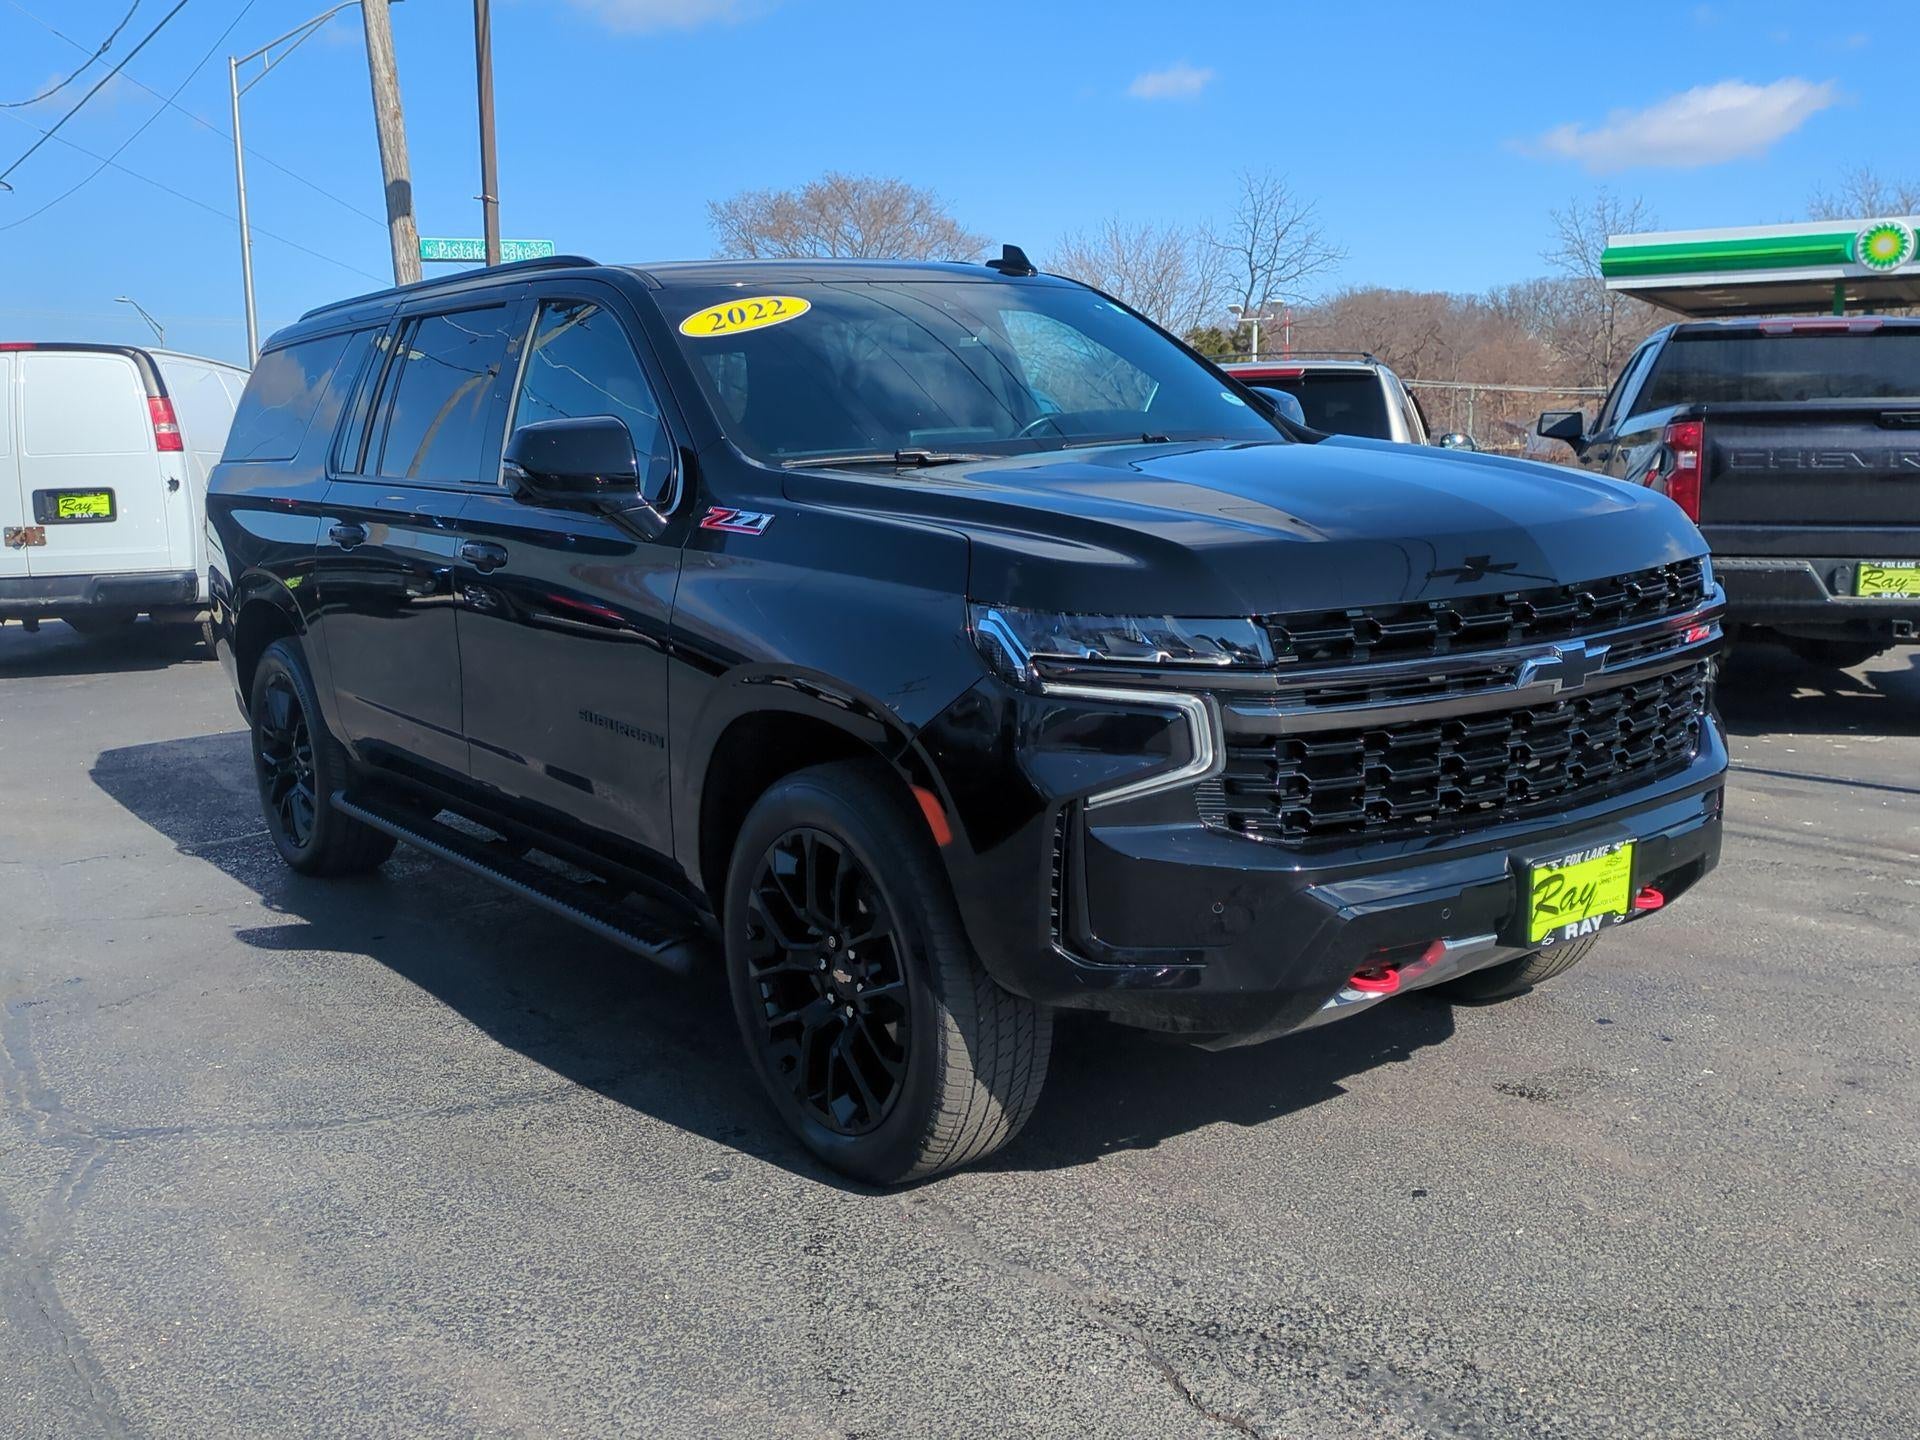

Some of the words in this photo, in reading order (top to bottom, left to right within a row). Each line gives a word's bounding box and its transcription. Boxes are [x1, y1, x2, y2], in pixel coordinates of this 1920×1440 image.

[438, 240, 487, 261] Pistake
[501, 243, 531, 262] Lake
[706, 299, 787, 332] 2022
[60, 498, 94, 513] Ray
[700, 506, 776, 536] Z71
[1897, 561, 1916, 569] LAKE
[1861, 570, 1909, 593] Ray
[1563, 853, 1582, 868] FOX
[1585, 844, 1611, 862] LAKE
[1531, 873, 1598, 923] Ray
[1564, 914, 1604, 941] RAY
